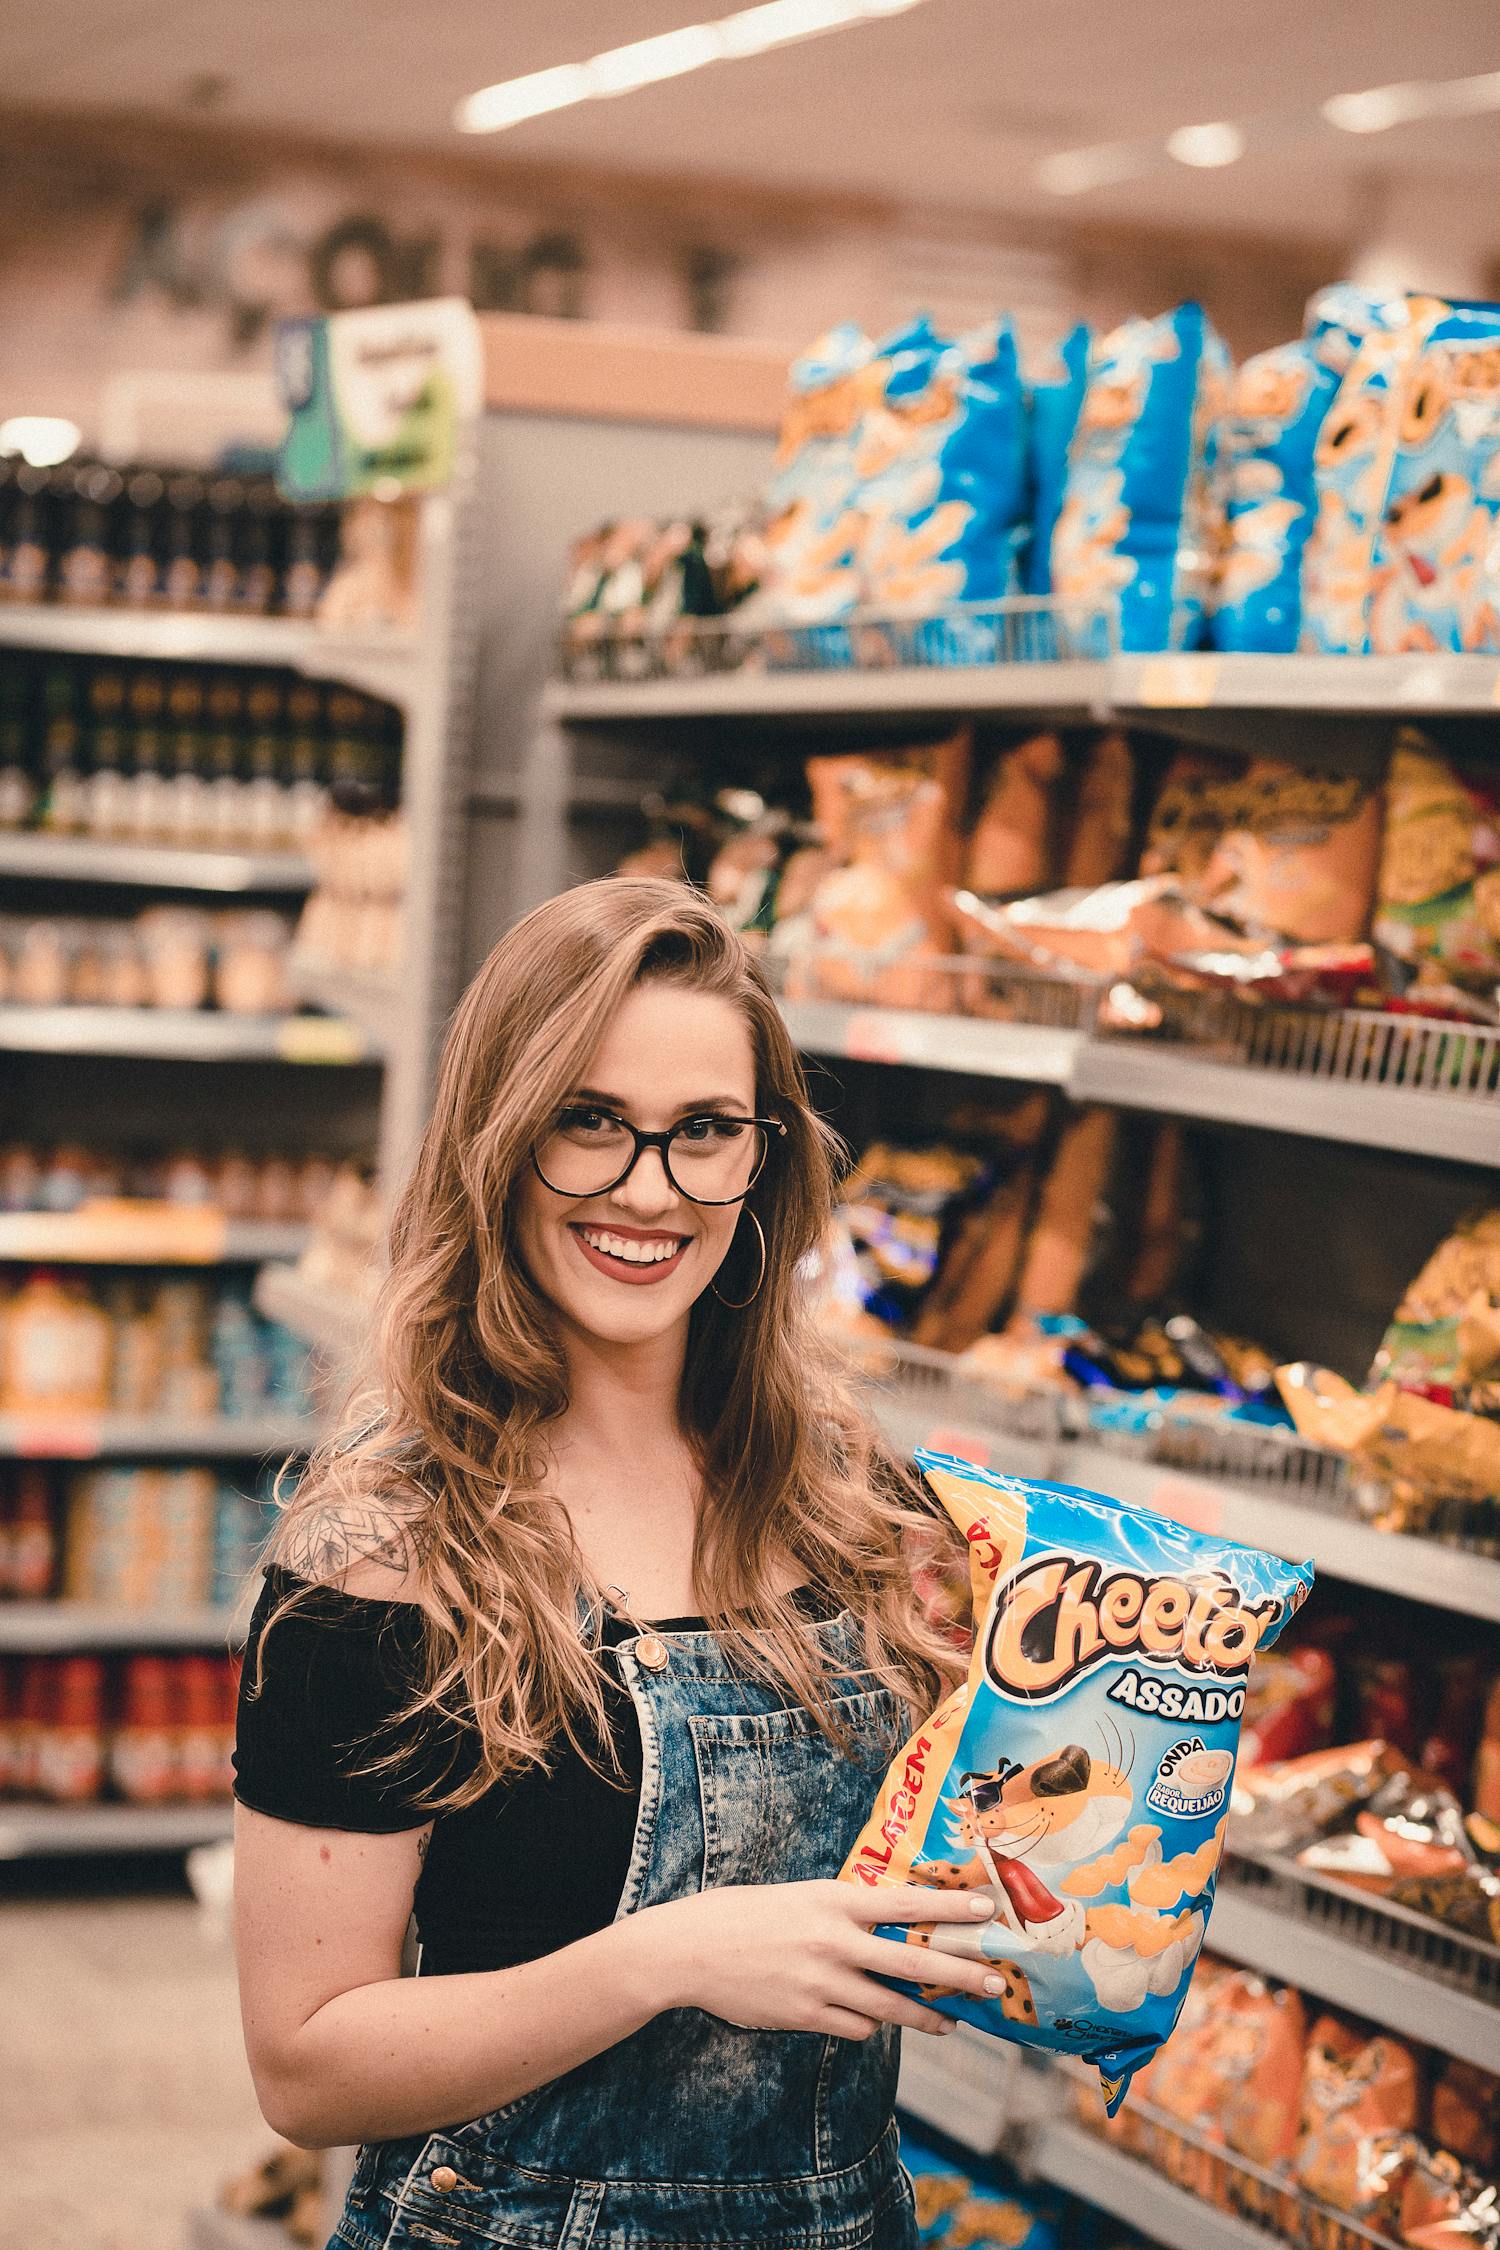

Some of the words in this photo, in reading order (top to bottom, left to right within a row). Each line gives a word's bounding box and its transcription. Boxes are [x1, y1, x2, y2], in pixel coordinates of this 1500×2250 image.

[1110, 1671, 1246, 1721] ASSADO
[1159, 1738, 1205, 1777] ONDA
[1149, 1789, 1223, 1814] REQUEIJÃO
[1155, 1782, 1182, 1798] SABOR
